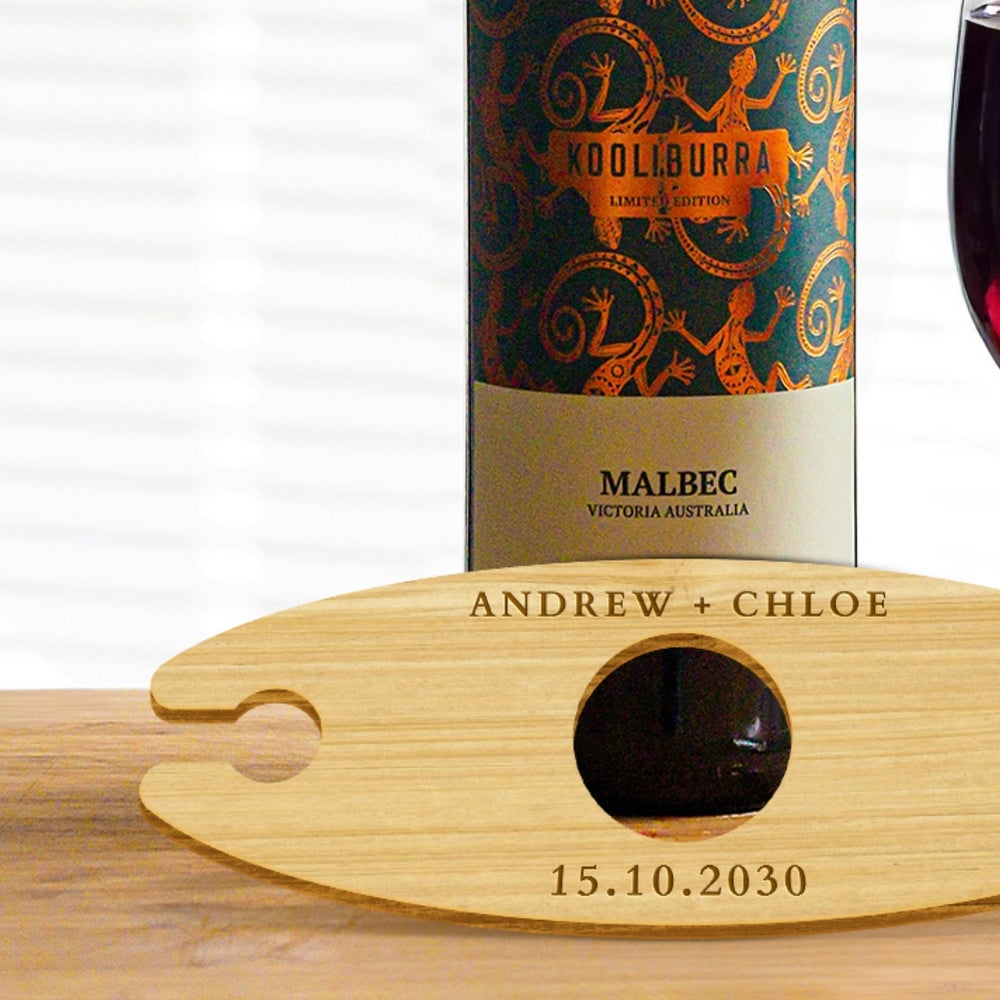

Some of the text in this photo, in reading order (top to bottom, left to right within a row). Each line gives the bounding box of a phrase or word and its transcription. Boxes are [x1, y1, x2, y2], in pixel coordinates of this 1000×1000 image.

[567, 142, 770, 177] KOOLIBURRA
[673, 194, 730, 207] EDITION
[600, 469, 738, 497] MALBEC
[586, 502, 750, 518] VICTORIA AUSTRALIA
[469, 590, 673, 618] ANDREW
[732, 590, 889, 618] CHLOE
[550, 864, 808, 897] 15.10.2030
